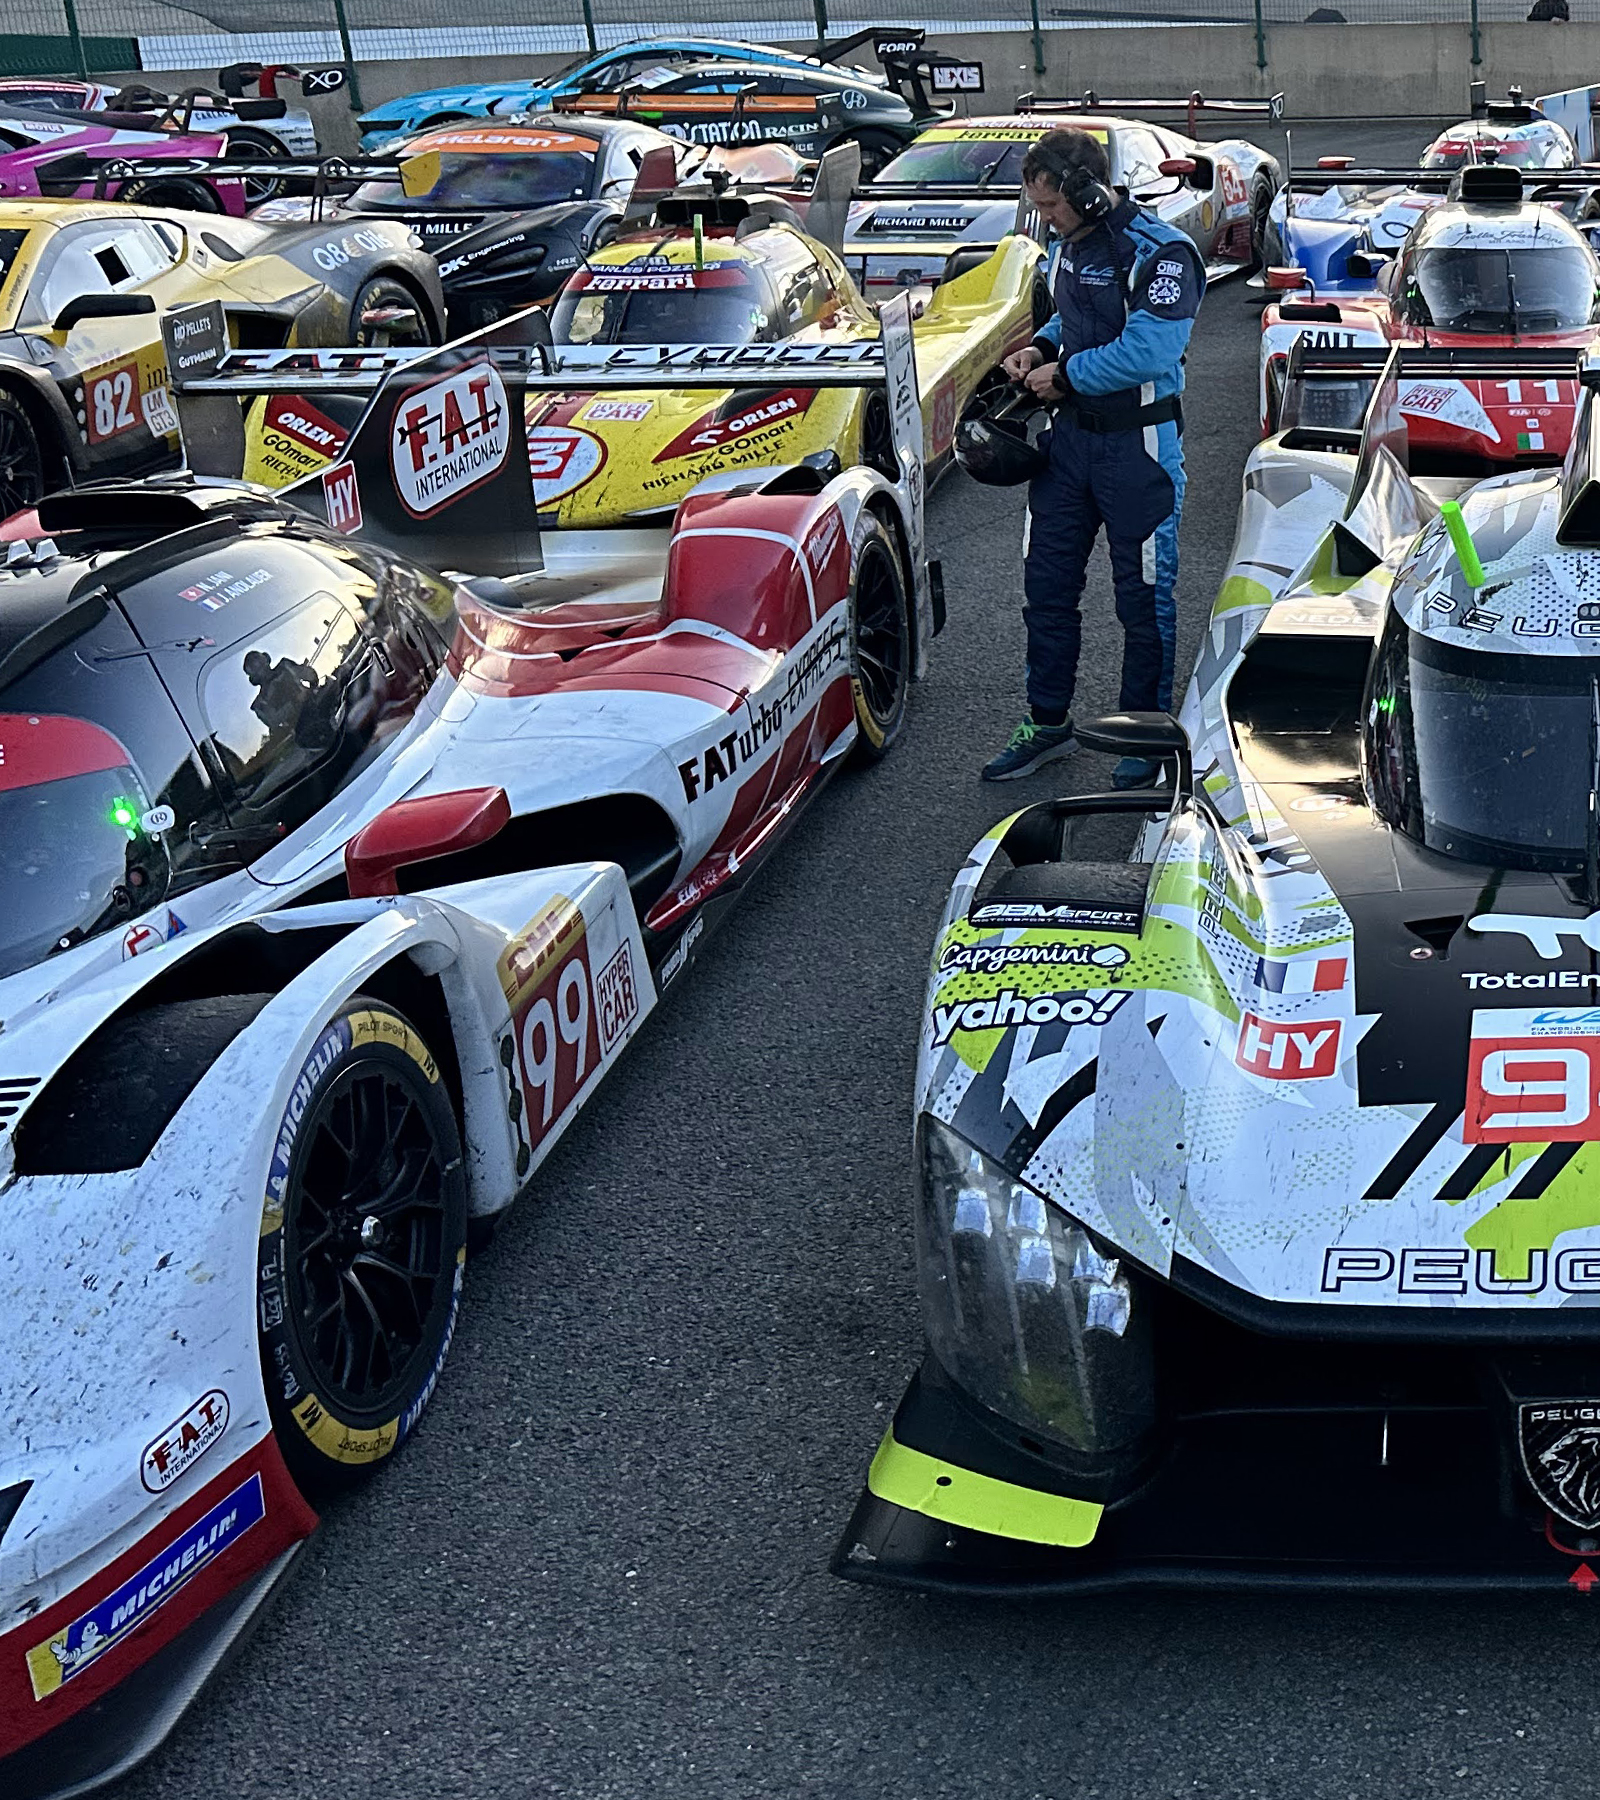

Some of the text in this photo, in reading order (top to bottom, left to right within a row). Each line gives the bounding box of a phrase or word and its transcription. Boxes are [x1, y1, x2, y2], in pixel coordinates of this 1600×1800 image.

[877, 42, 917, 54] FORD
[308, 70, 343, 89] XO
[932, 66, 981, 89] NEXIS
[427, 133, 552, 148] McLaren
[763, 122, 820, 138] RACIN
[957, 130, 1041, 139] Ferrar
[1223, 166, 1245, 203] 54
[873, 216, 969, 227] RICHARD MILLE
[311, 231, 393, 272] Q8 Oils
[438, 232, 526, 279] DK Engineering
[583, 273, 696, 291] Ferrari
[1157, 262, 1184, 274] OMP
[1302, 330, 1358, 349] SALT
[93, 370, 136, 437] 82
[147, 391, 165, 412] LM
[1402, 394, 1445, 412] CAR
[1412, 384, 1452, 400] HYPER
[1494, 379, 1561, 404] 11
[150, 408, 175, 433] GT3
[588, 408, 642, 420] CAR
[592, 402, 650, 412] HYPER
[727, 397, 798, 432] ORLEN
[277, 412, 334, 446] ORLEN
[718, 420, 795, 456] GOmart
[262, 433, 323, 470] GOmart
[260, 454, 306, 480] RICHA
[415, 435, 503, 501] INTERNATIONAL
[642, 445, 786, 492] RICHARD MILLE
[325, 479, 354, 528] HY
[1197, 828, 1230, 941] PEUGE
[971, 917, 1137, 928] MOTORSPORT ENGINEERING
[938, 943, 1090, 973] Capgemini
[597, 953, 630, 1010] HYPER
[357, 1021, 380, 1034] PILOT
[602, 983, 637, 1052] CAR
[933, 990, 1132, 1048] yahoo!
[522, 963, 589, 1131] 99
[1243, 1025, 1336, 1070] HY
[275, 1033, 346, 1176] MICHELIN
[160, 1421, 224, 1484] INTERNATIONAL
[110, 1508, 238, 1630] MICHELIN
